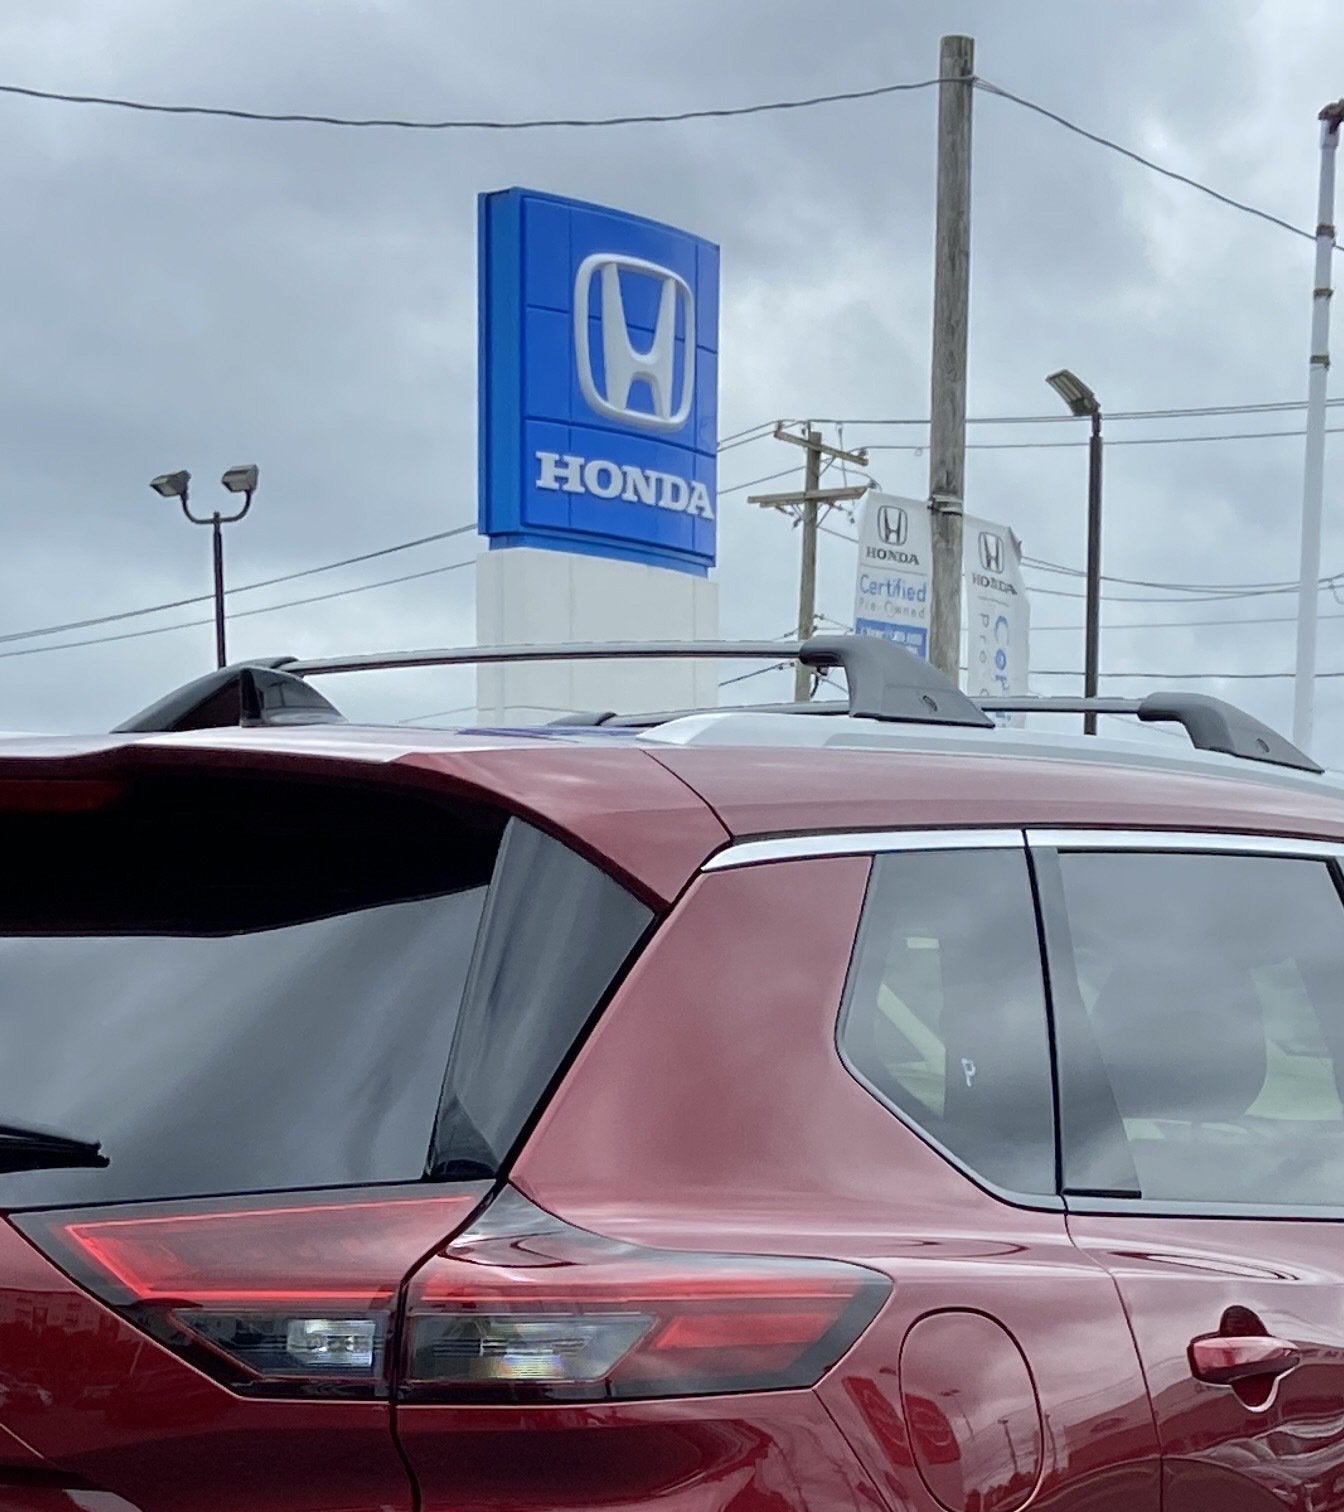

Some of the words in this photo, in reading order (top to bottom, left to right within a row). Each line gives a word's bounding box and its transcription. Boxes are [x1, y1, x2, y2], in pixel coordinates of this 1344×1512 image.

[535, 450, 715, 520] HONDA
[866, 546, 919, 566] HONDA
[860, 574, 926, 602] Certified
[971, 573, 1018, 596] HONDA
